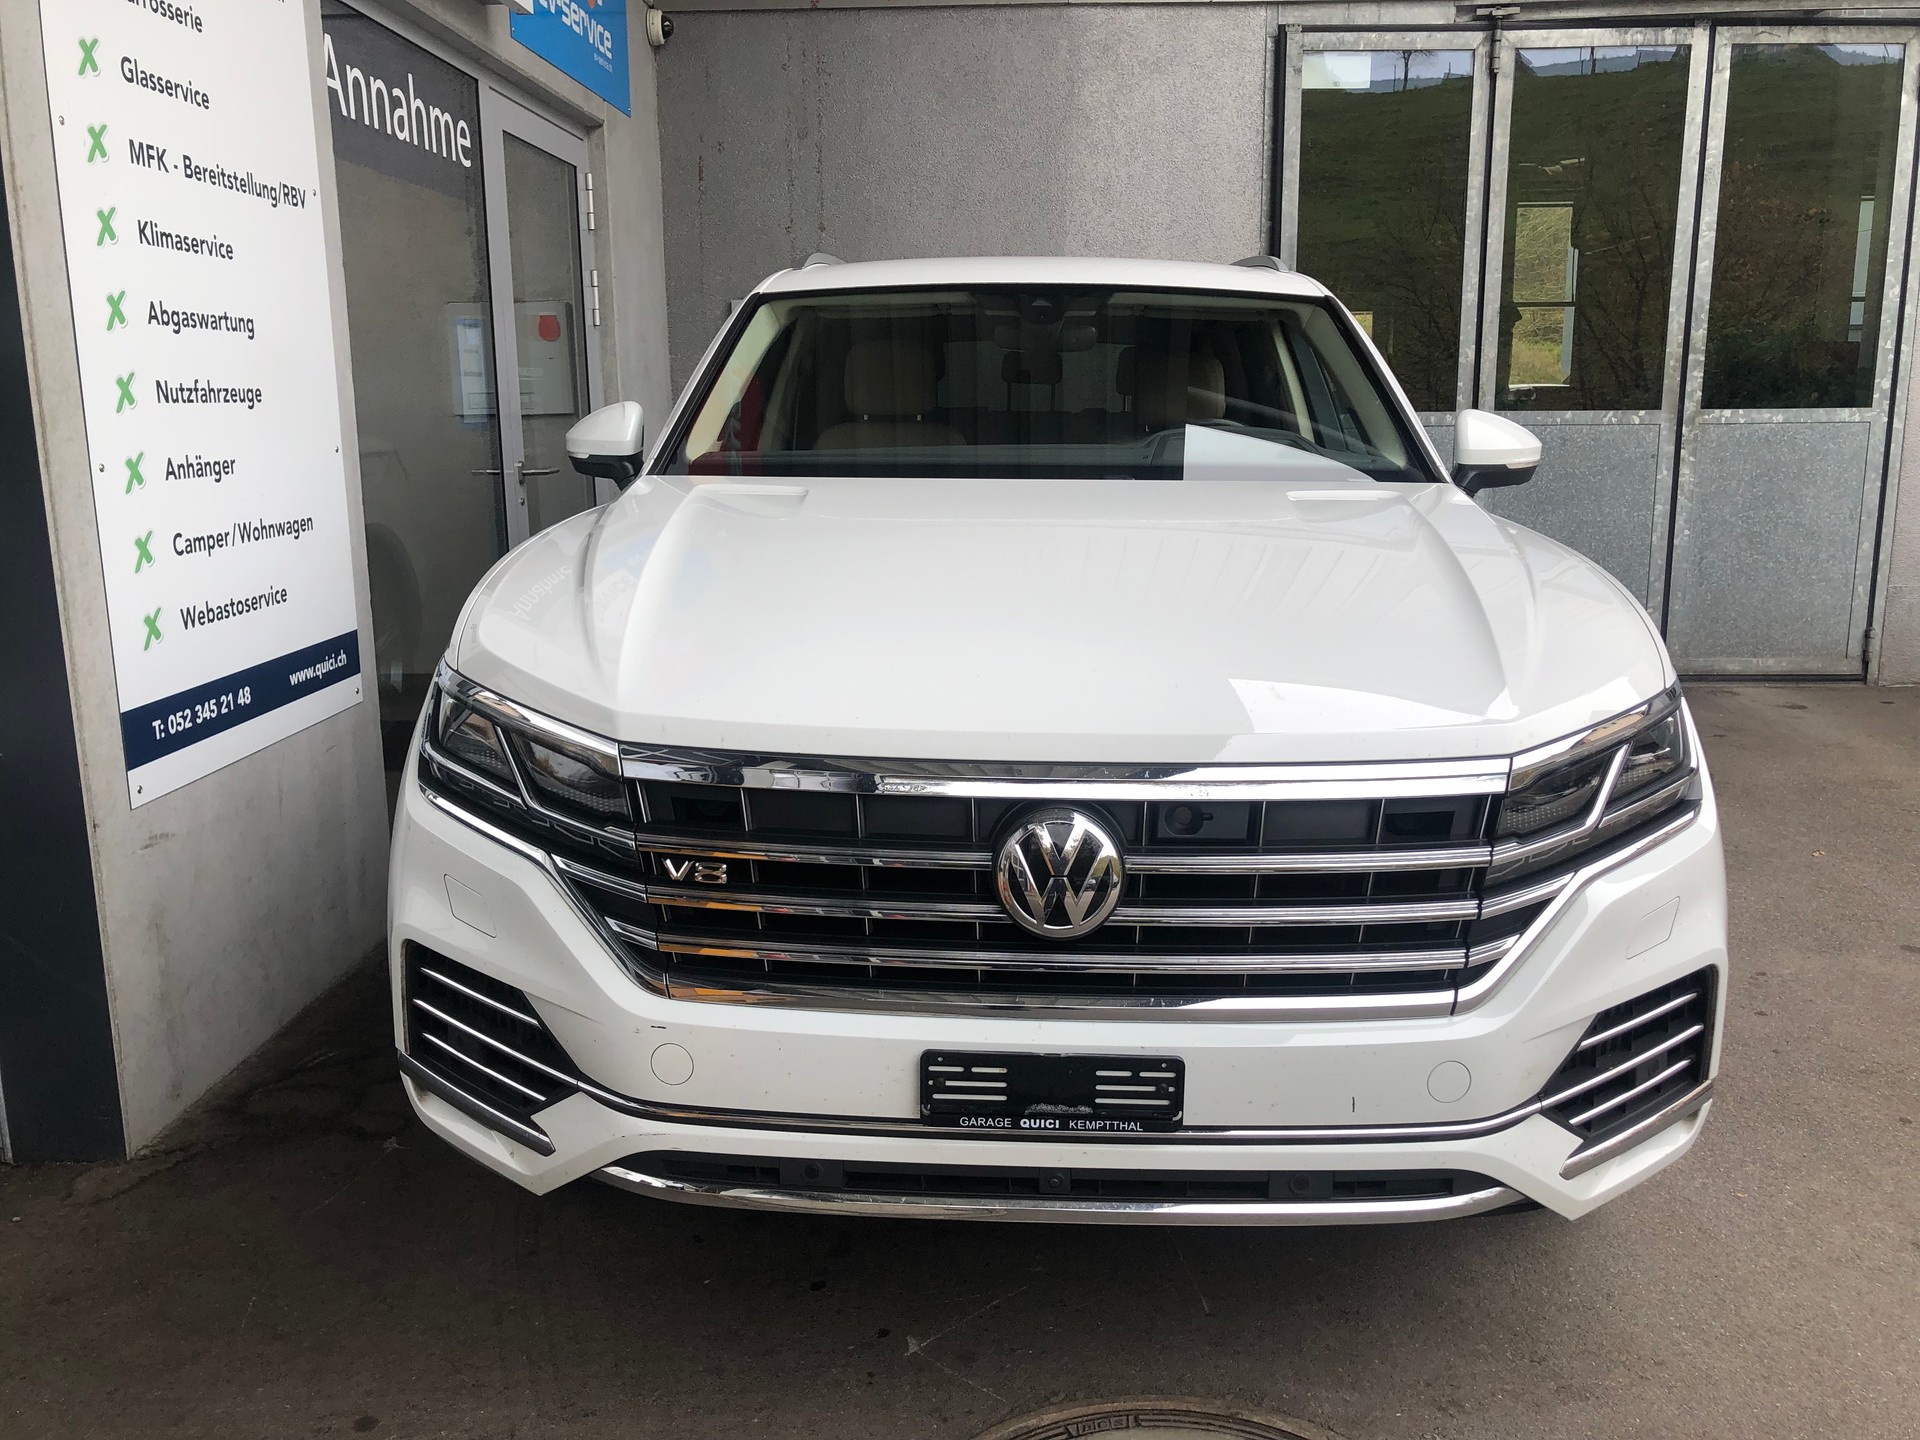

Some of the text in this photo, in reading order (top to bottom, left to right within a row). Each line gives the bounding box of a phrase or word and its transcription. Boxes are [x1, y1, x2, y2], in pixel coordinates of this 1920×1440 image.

[120, 56, 210, 110] Glasservice
[323, 33, 472, 168] Annahme
[129, 139, 169, 173] MFK
[182, 154, 306, 209] Bereitstellung/RBV
[137, 219, 234, 260] Klimaservice
[147, 300, 255, 340] Abgaswartung
[155, 379, 263, 410] Nutzfahrzeuge
[165, 454, 236, 483] Anhänger
[180, 585, 288, 630] Webastoservice
[289, 649, 347, 687] www.quici.ch
[152, 685, 252, 740] T: 052 345 21 48
[661, 858, 727, 884] V8
[959, 1116, 1144, 1131] GARAGE QUICI KEMPTTHAL
